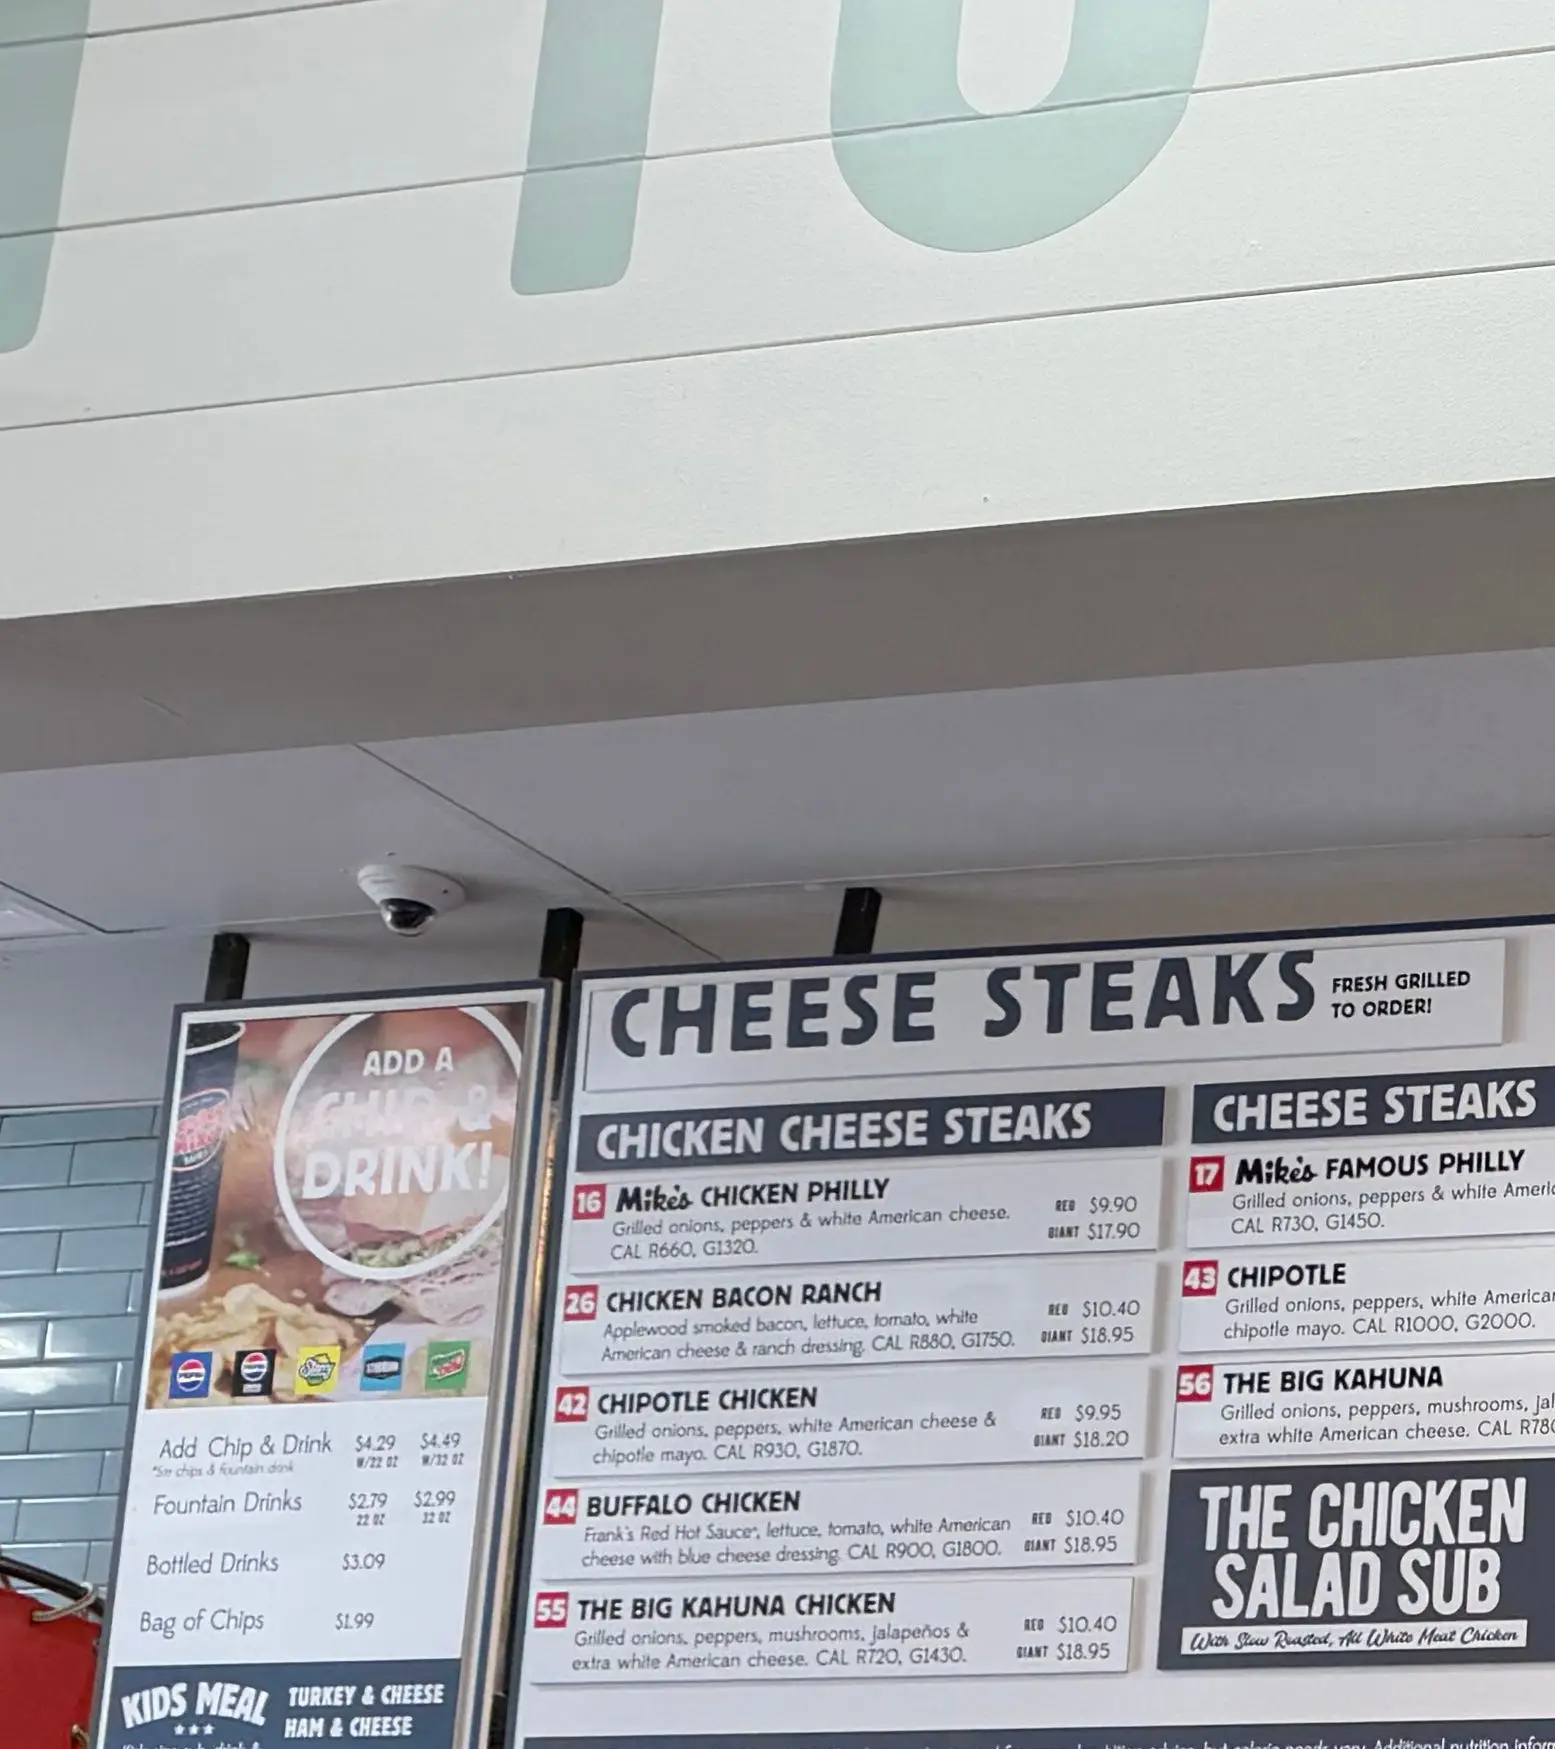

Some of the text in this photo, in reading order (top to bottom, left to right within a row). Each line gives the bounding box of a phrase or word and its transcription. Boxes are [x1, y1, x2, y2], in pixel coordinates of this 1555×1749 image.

[1333, 971, 1470, 993] FRESH GRILLED
[612, 949, 1314, 1057] CHEESE STEAKS
[1332, 998, 1431, 1018] TO ORDER!
[363, 1047, 455, 1077] ADD A
[598, 1102, 1090, 1159] CHICKEN CHEESE STEAKS
[303, 1144, 492, 1199] DRINK!
[1196, 1150, 1525, 1185] 17 Mike's FAMOUS PHILLY
[1233, 1192, 1285, 1210] Grilled
[1292, 1192, 1351, 1207] onions,
[1359, 1191, 1424, 1209] peppers
[1432, 1185, 1444, 1201] &
[1452, 1183, 1497, 1200] white
[160, 1431, 461, 1462] Add Chip & Drink $4.29 $4.49
[154, 1489, 455, 1515] Fountain Drinks $2.79 $2.99
[1200, 1477, 1526, 1550] THE CHICKEN
[146, 1551, 385, 1575] Bottled Drinks $3.09
[1213, 1548, 1500, 1619] SALAD SUB
[140, 1608, 374, 1639] Bag of Chips $1.99
[122, 1682, 268, 1728] KIDS MEAL
